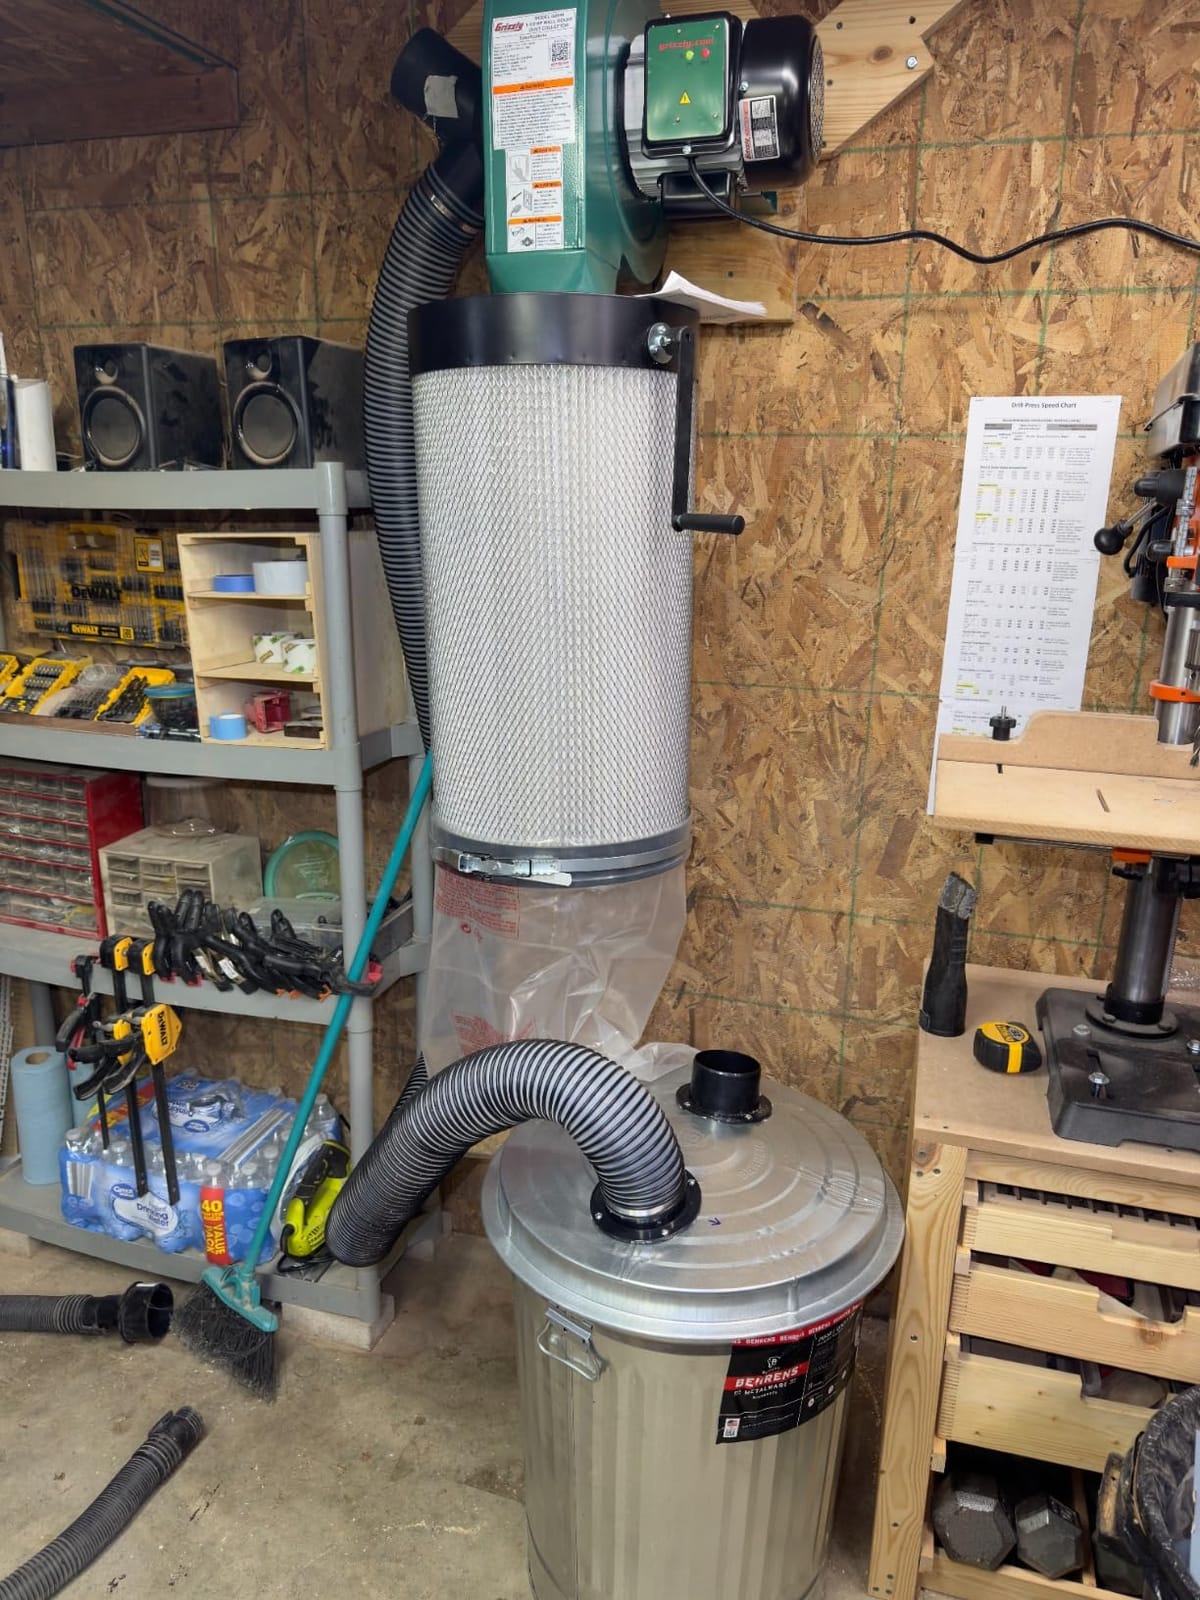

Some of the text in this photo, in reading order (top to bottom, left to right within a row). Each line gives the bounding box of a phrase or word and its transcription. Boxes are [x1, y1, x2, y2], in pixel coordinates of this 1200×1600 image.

[494, 22, 524, 32] Grizzly
[658, 38, 714, 51] grizzly.com
[1041, 402, 1059, 410] Speed
[201, 1199, 223, 1212] 40
[205, 1225, 215, 1254] PACK
[214, 1223, 226, 1255] VALUE
[735, 1366, 800, 1389] BEHRENS
